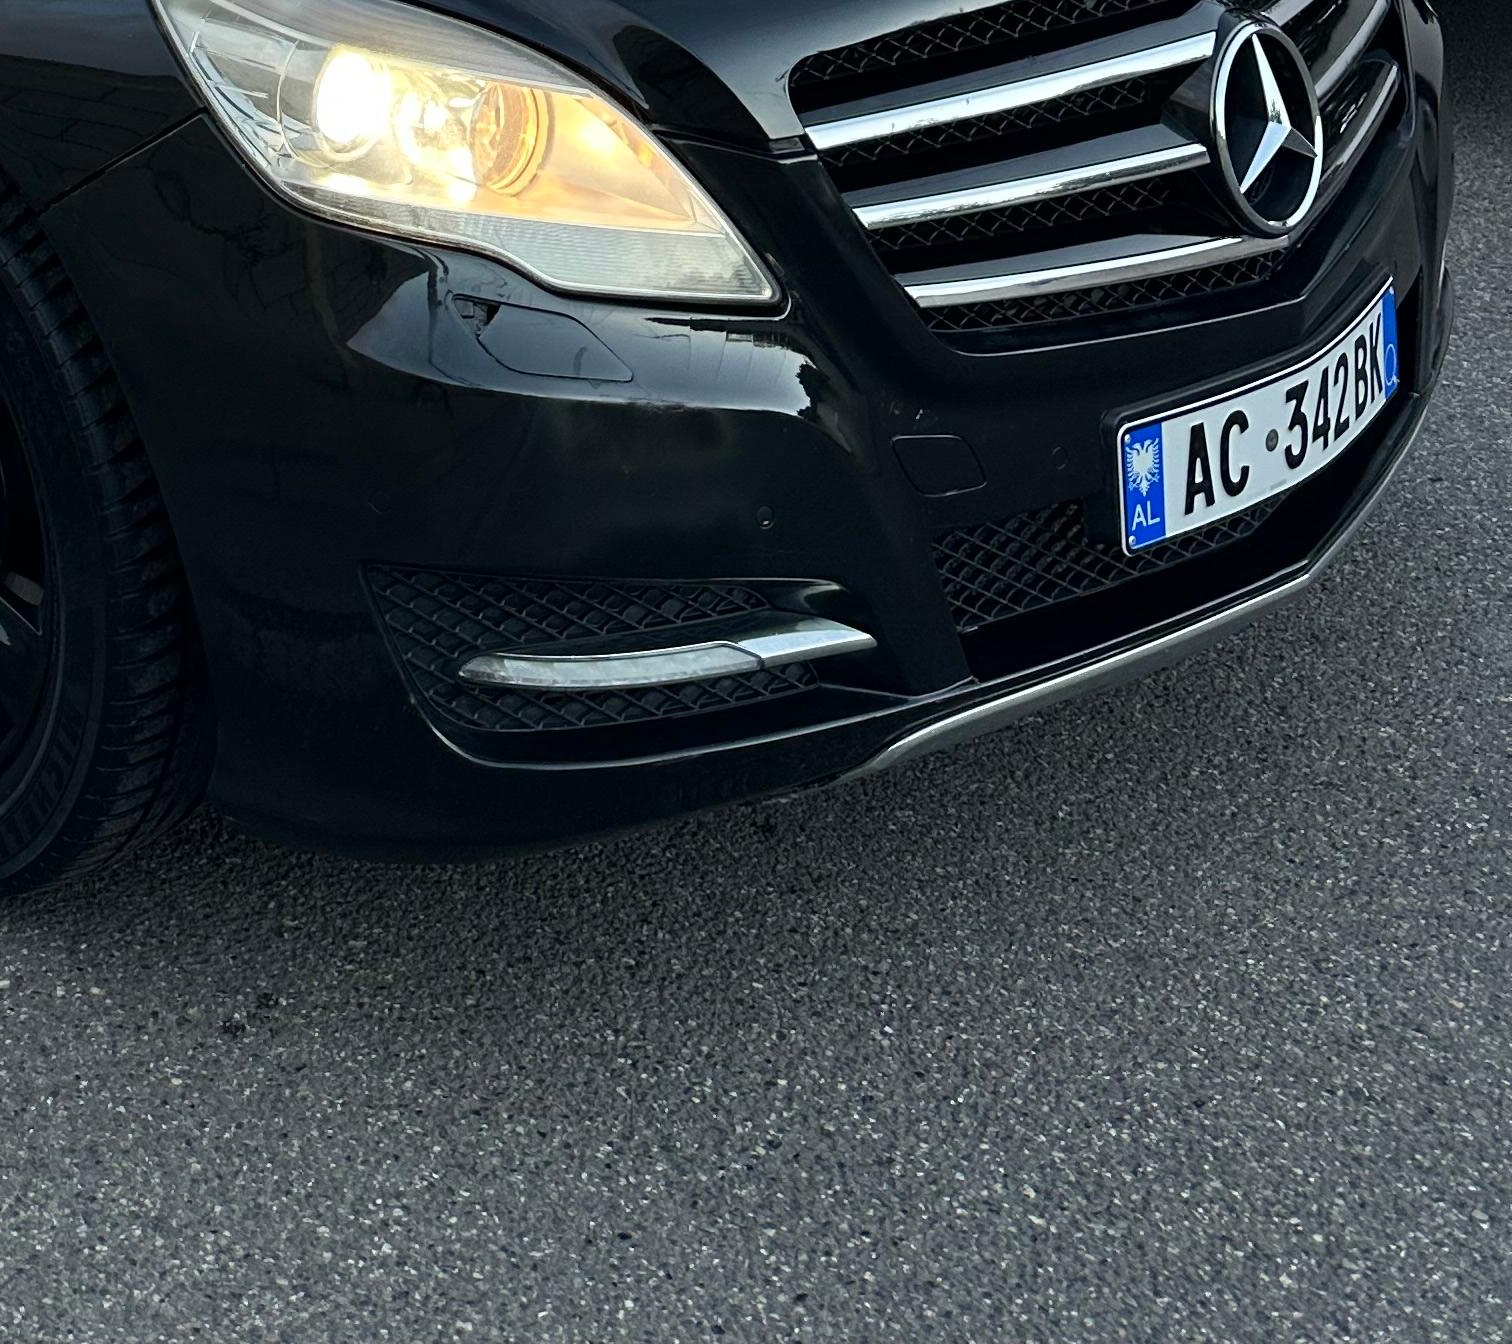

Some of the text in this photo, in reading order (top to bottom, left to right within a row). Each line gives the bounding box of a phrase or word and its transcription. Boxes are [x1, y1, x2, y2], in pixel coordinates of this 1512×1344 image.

[1184, 311, 1384, 516] AC 342BK
[1131, 500, 1161, 531] AL
